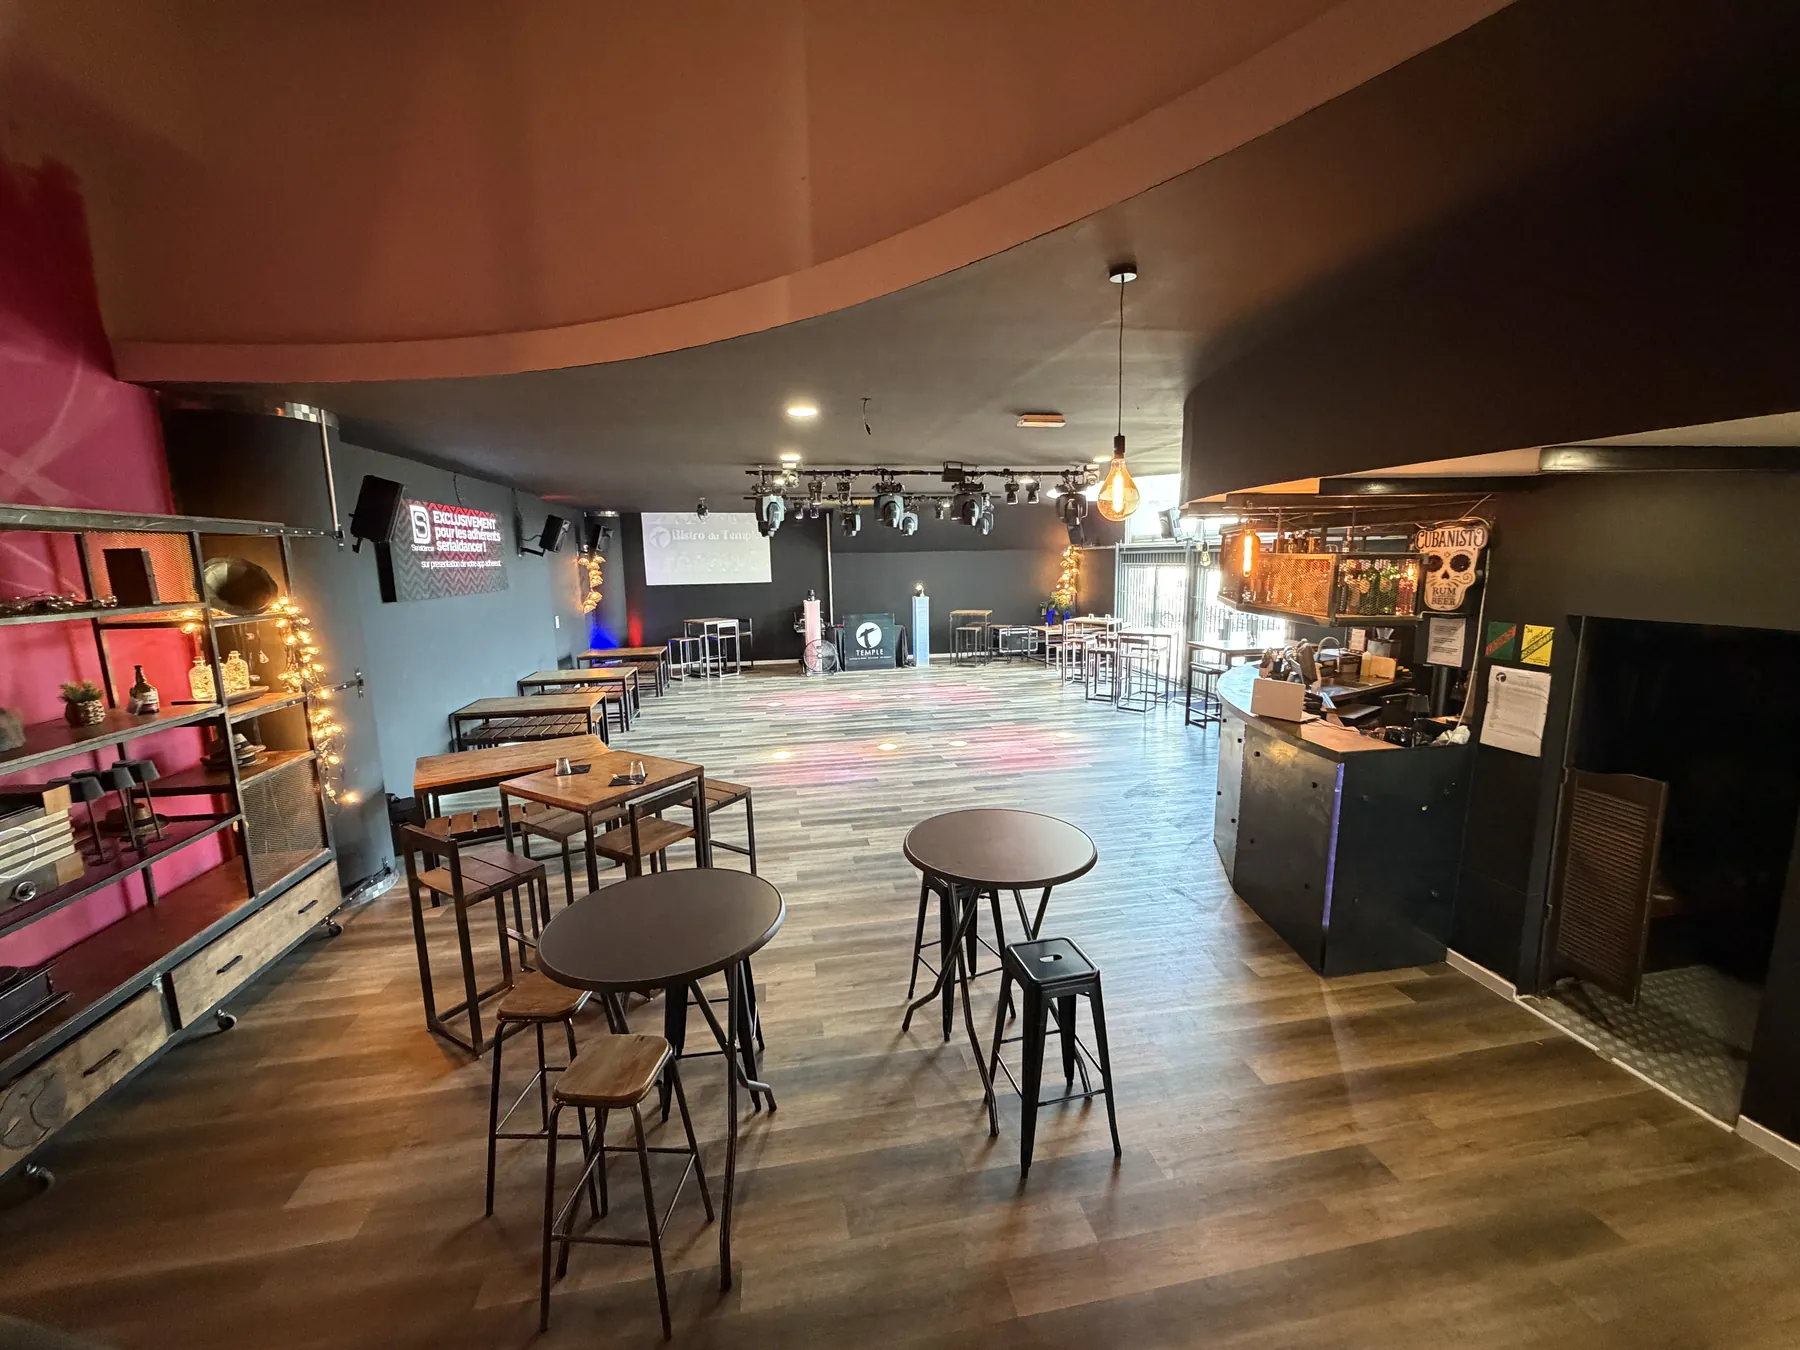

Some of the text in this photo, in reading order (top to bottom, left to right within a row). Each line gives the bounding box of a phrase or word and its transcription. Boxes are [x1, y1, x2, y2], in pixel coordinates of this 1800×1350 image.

[433, 510, 496, 530] EXCLUSIVEMENT
[435, 526, 455, 540] pour
[455, 526, 467, 539] les
[1416, 528, 1484, 549] CUBANISTO
[1432, 587, 1456, 595] RUM
[1431, 597, 1456, 606] BEER
